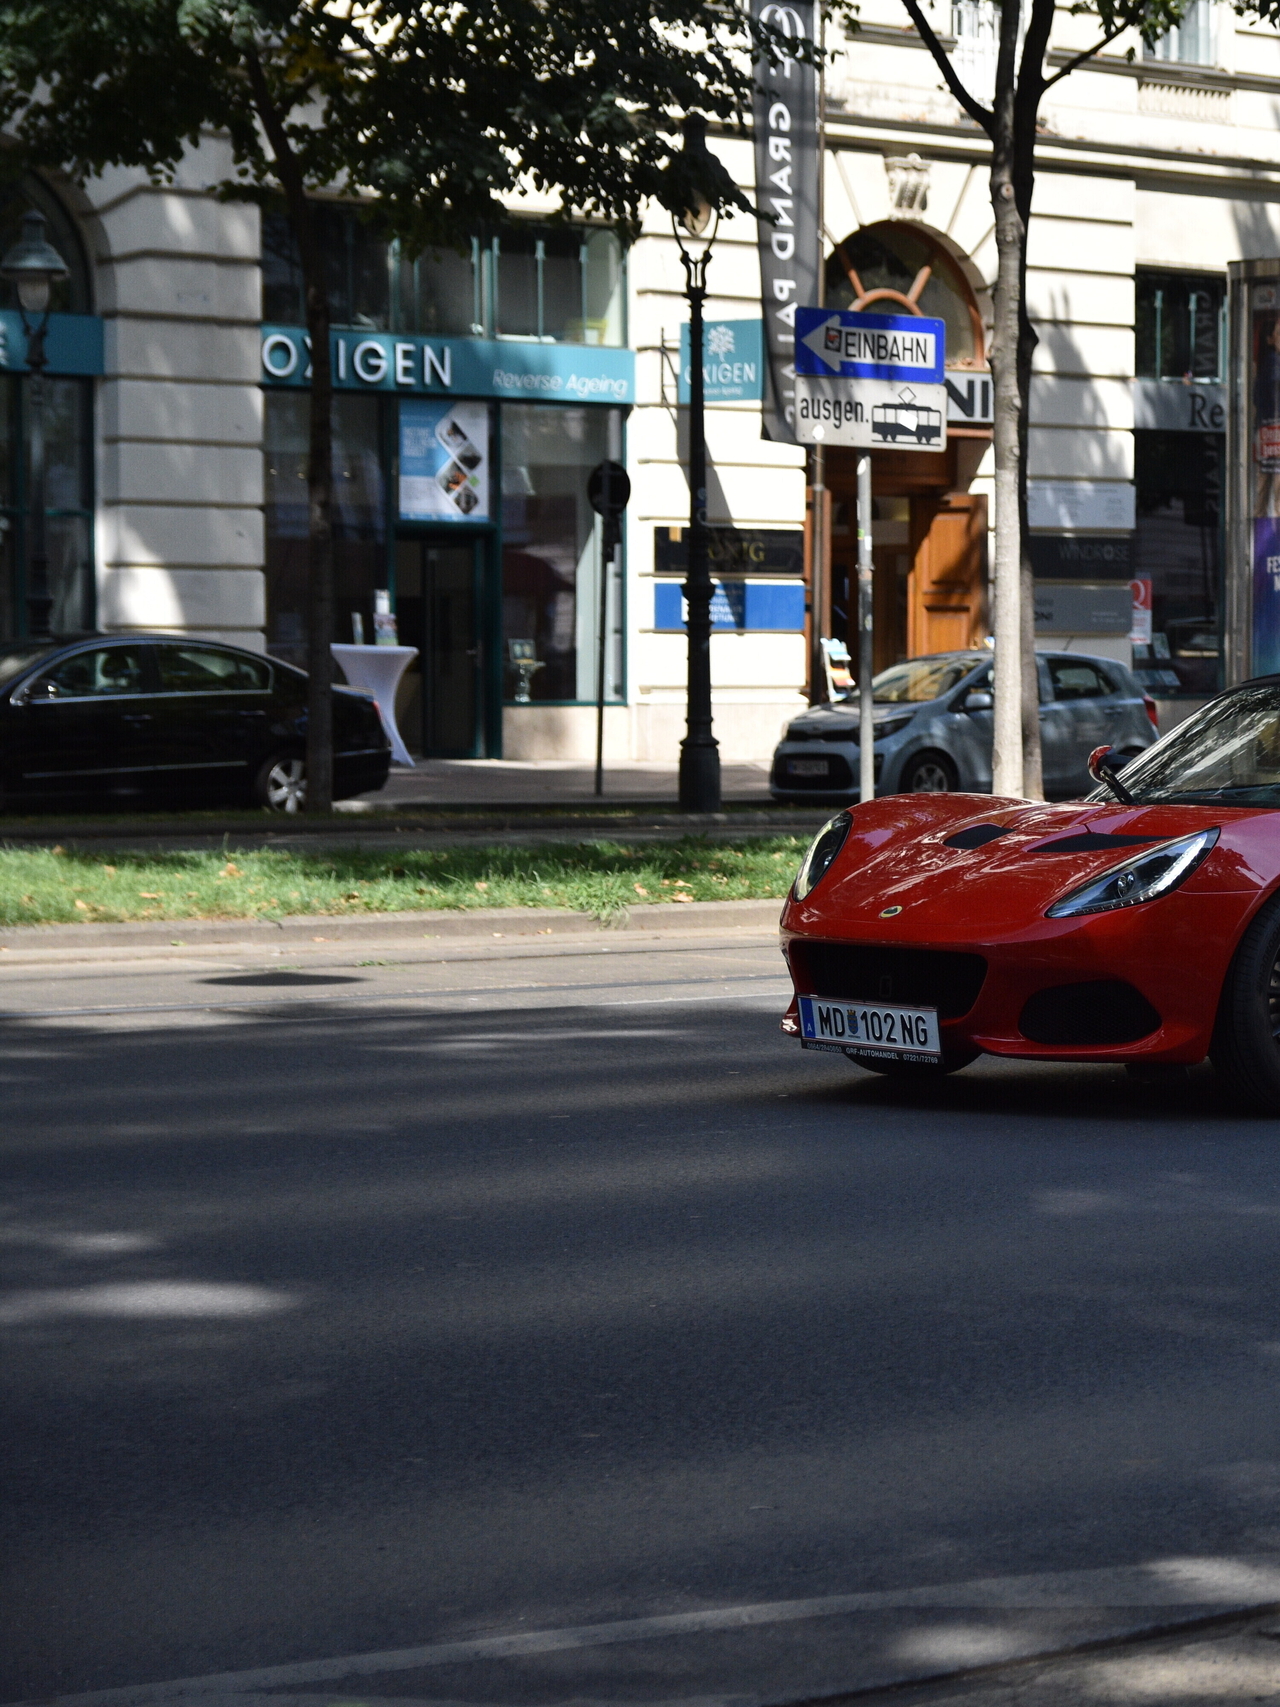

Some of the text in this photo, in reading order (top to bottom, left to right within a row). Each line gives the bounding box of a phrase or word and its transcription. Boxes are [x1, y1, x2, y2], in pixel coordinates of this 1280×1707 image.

[261, 333, 451, 387] OIGEN
[844, 332, 928, 363] EINBAHN
[492, 368, 628, 401] Reverse Ageing
[800, 398, 869, 429] ausgen.
[806, 1022, 813, 1032] A
[818, 1004, 928, 1046] MD 102 NG
[845, 1047, 899, 1060] GRF-AUTOHANDEL
